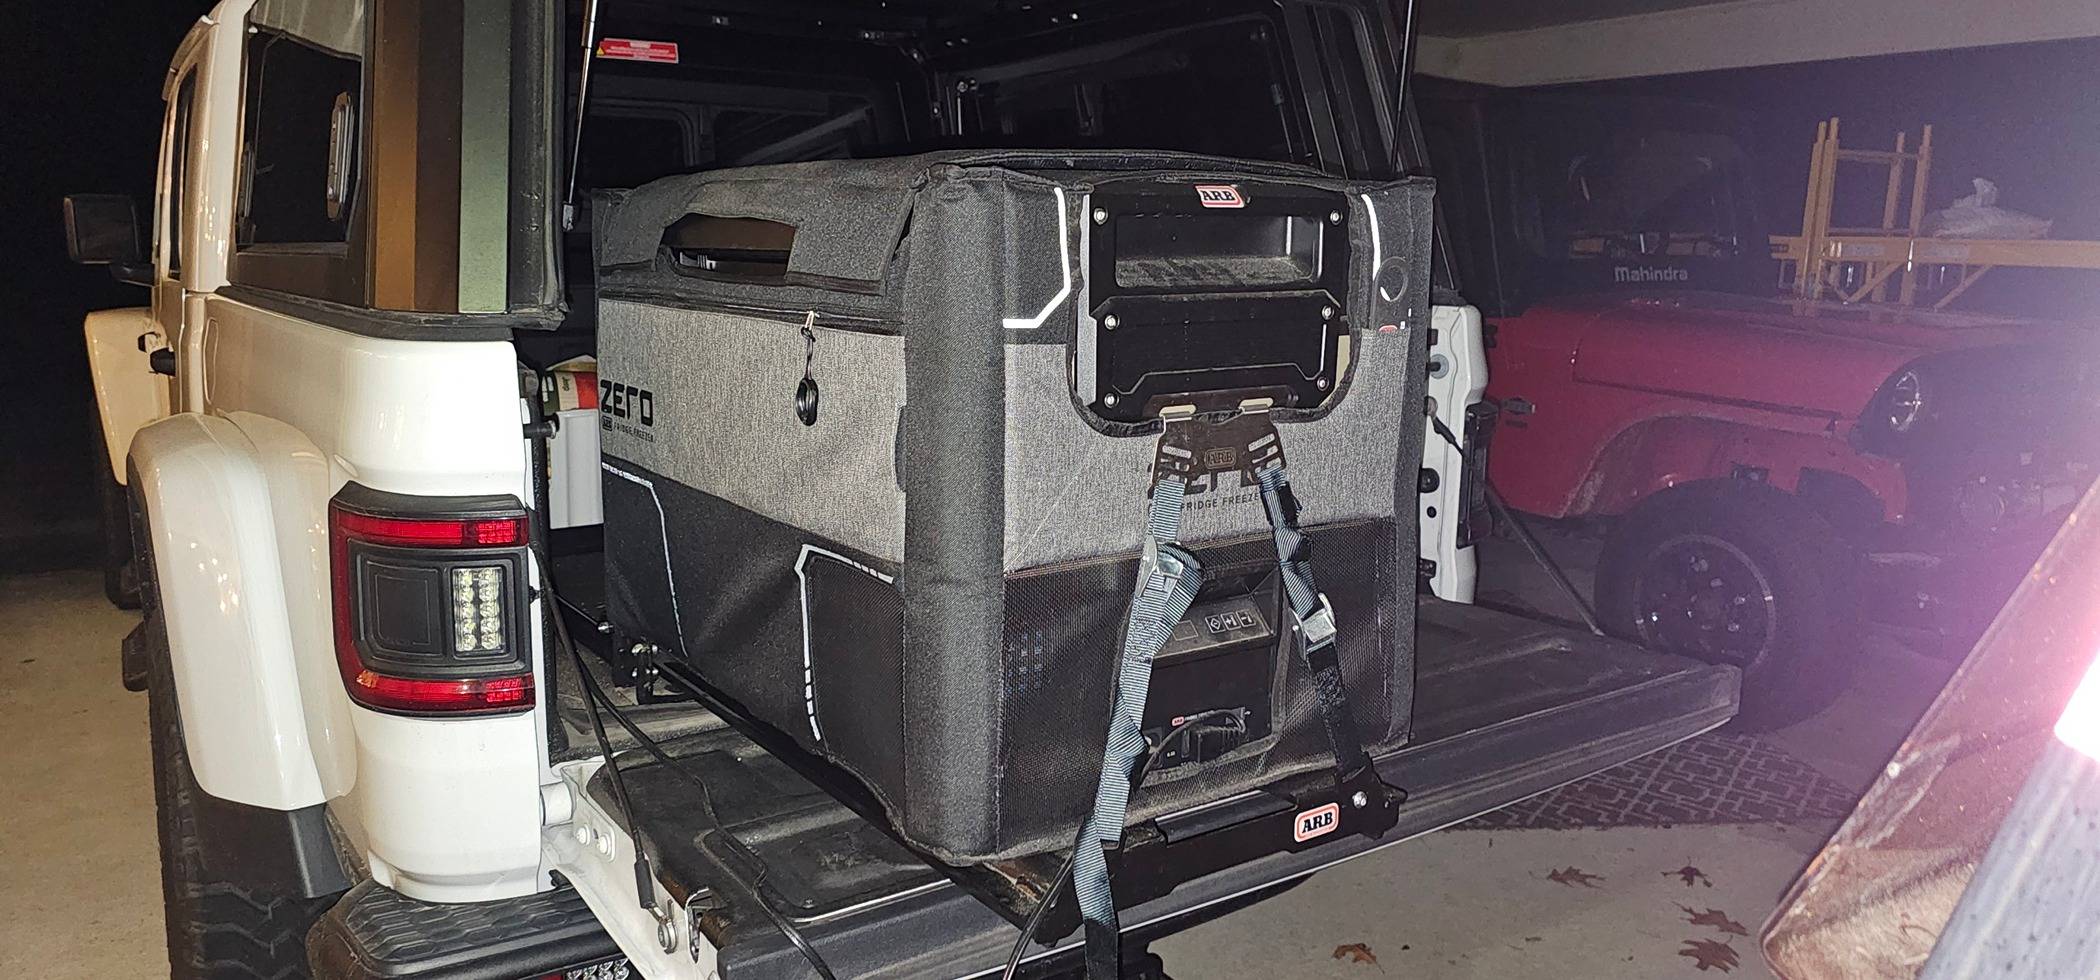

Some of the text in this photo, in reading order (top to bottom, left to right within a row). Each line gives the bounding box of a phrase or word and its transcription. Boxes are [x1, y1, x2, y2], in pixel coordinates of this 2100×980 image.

[1200, 190, 1235, 201] ARB
[1614, 265, 1688, 281] Mahindra
[1207, 449, 1234, 465] ARB
[1180, 493, 1260, 511] FRIDGE FREEZE
[1302, 812, 1333, 833] ARB
